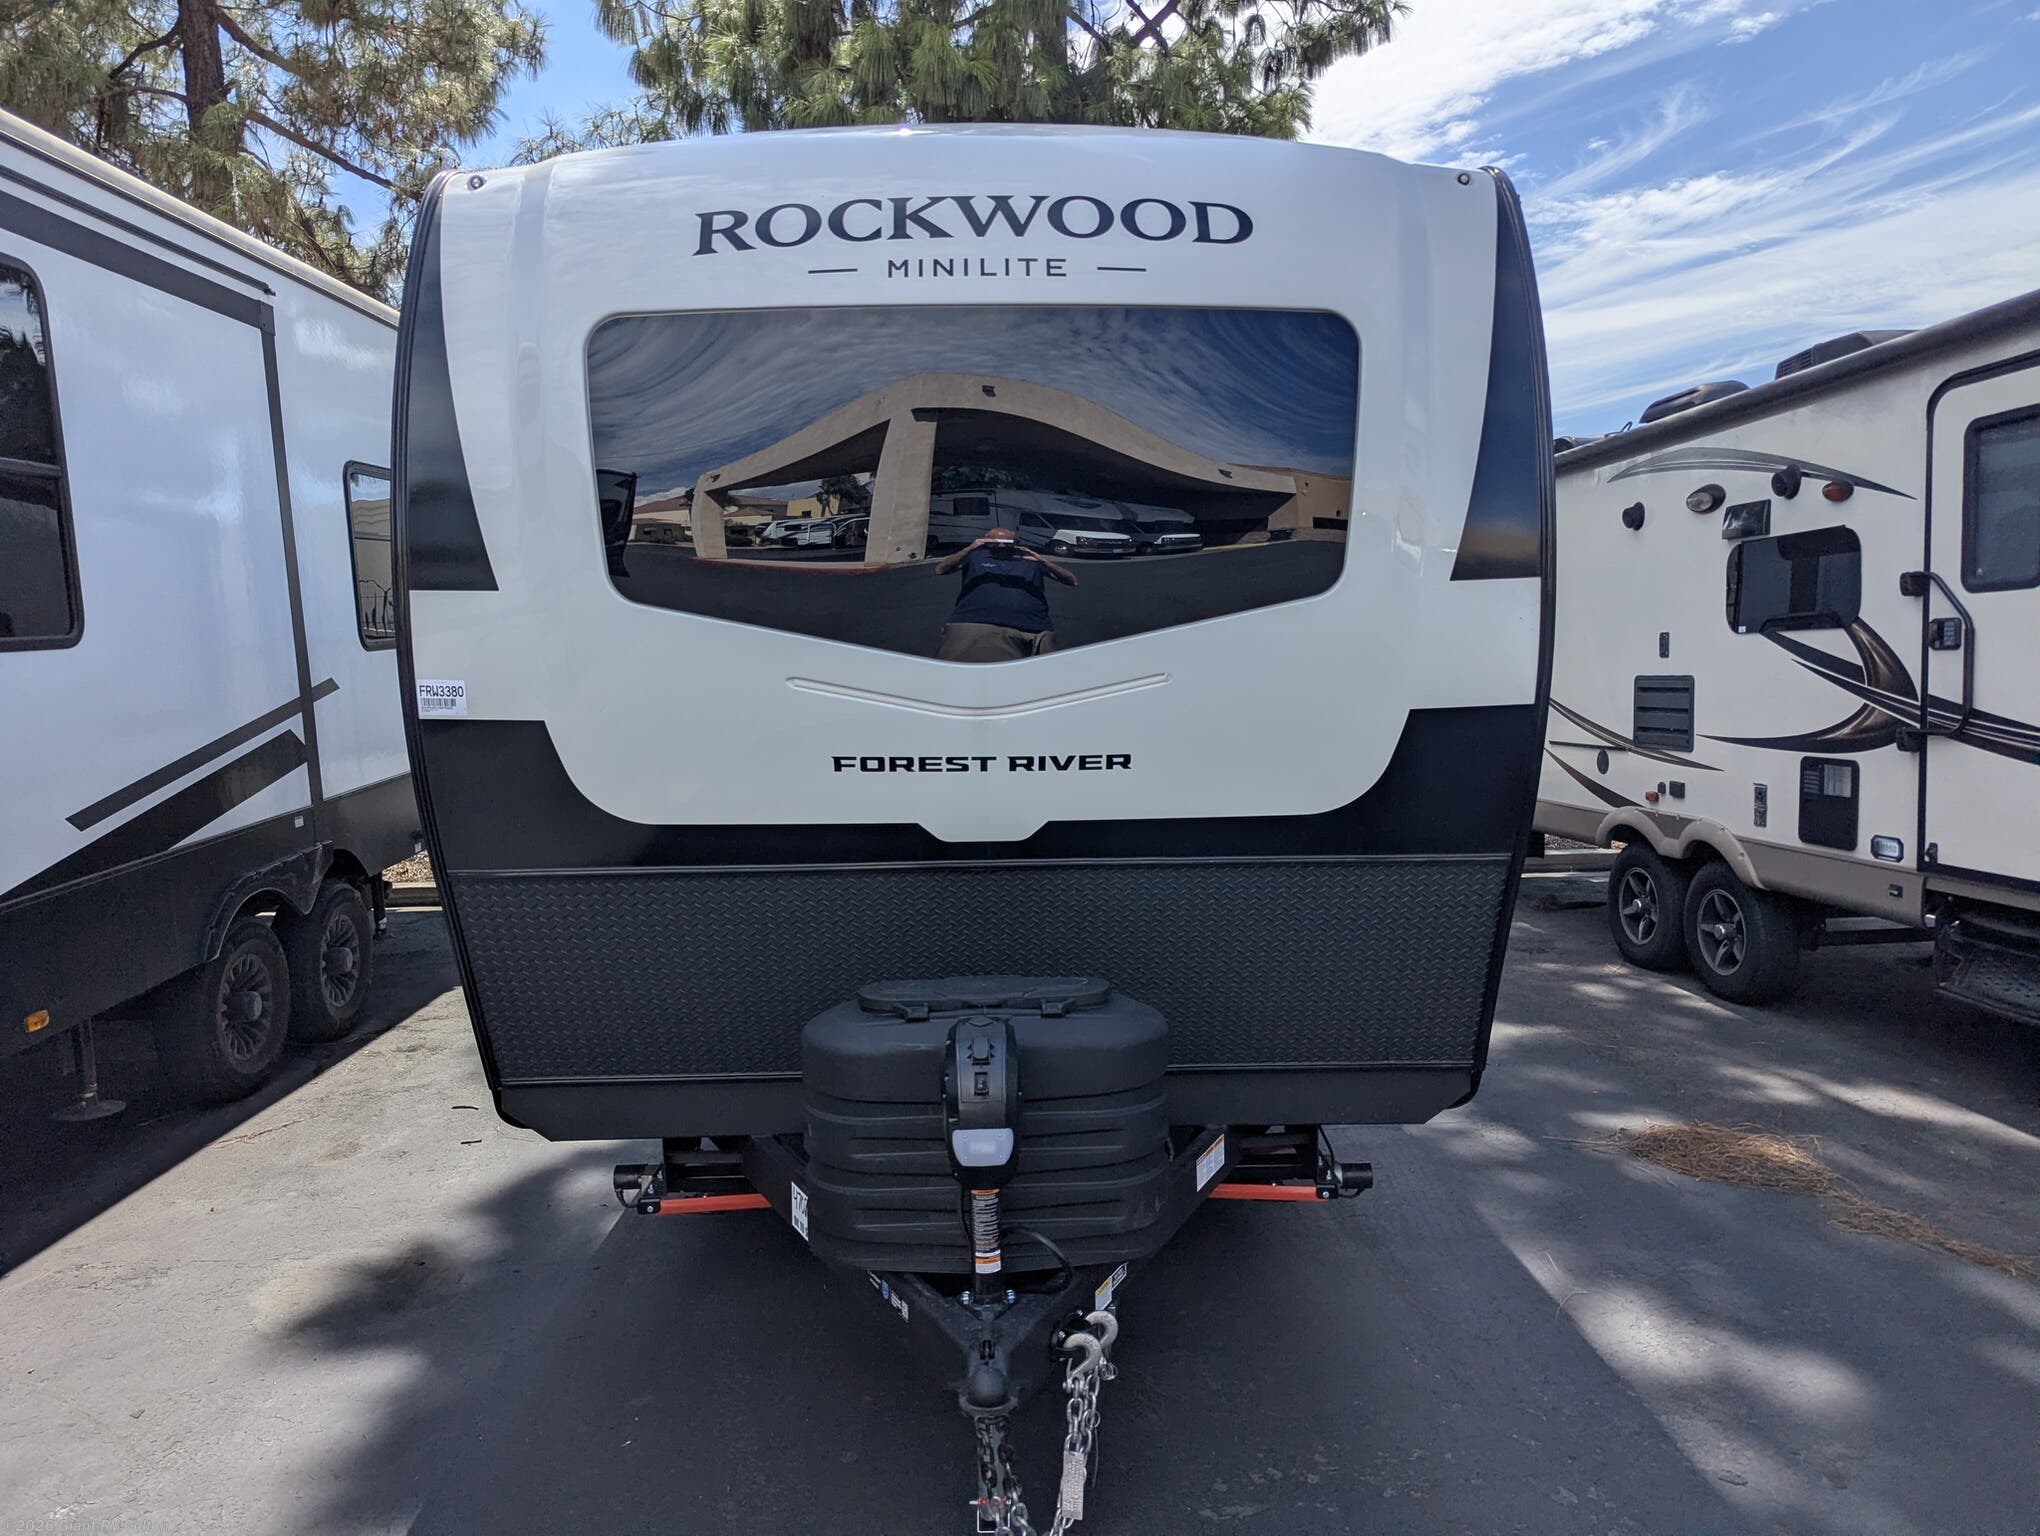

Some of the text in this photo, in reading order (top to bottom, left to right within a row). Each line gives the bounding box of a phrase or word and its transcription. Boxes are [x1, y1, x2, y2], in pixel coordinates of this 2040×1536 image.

[692, 195, 1254, 257] ROCKWOOD
[888, 258, 1067, 278] MINILITE
[419, 685, 464, 698] FRW3380
[831, 753, 1132, 773] FOREST RIVER
